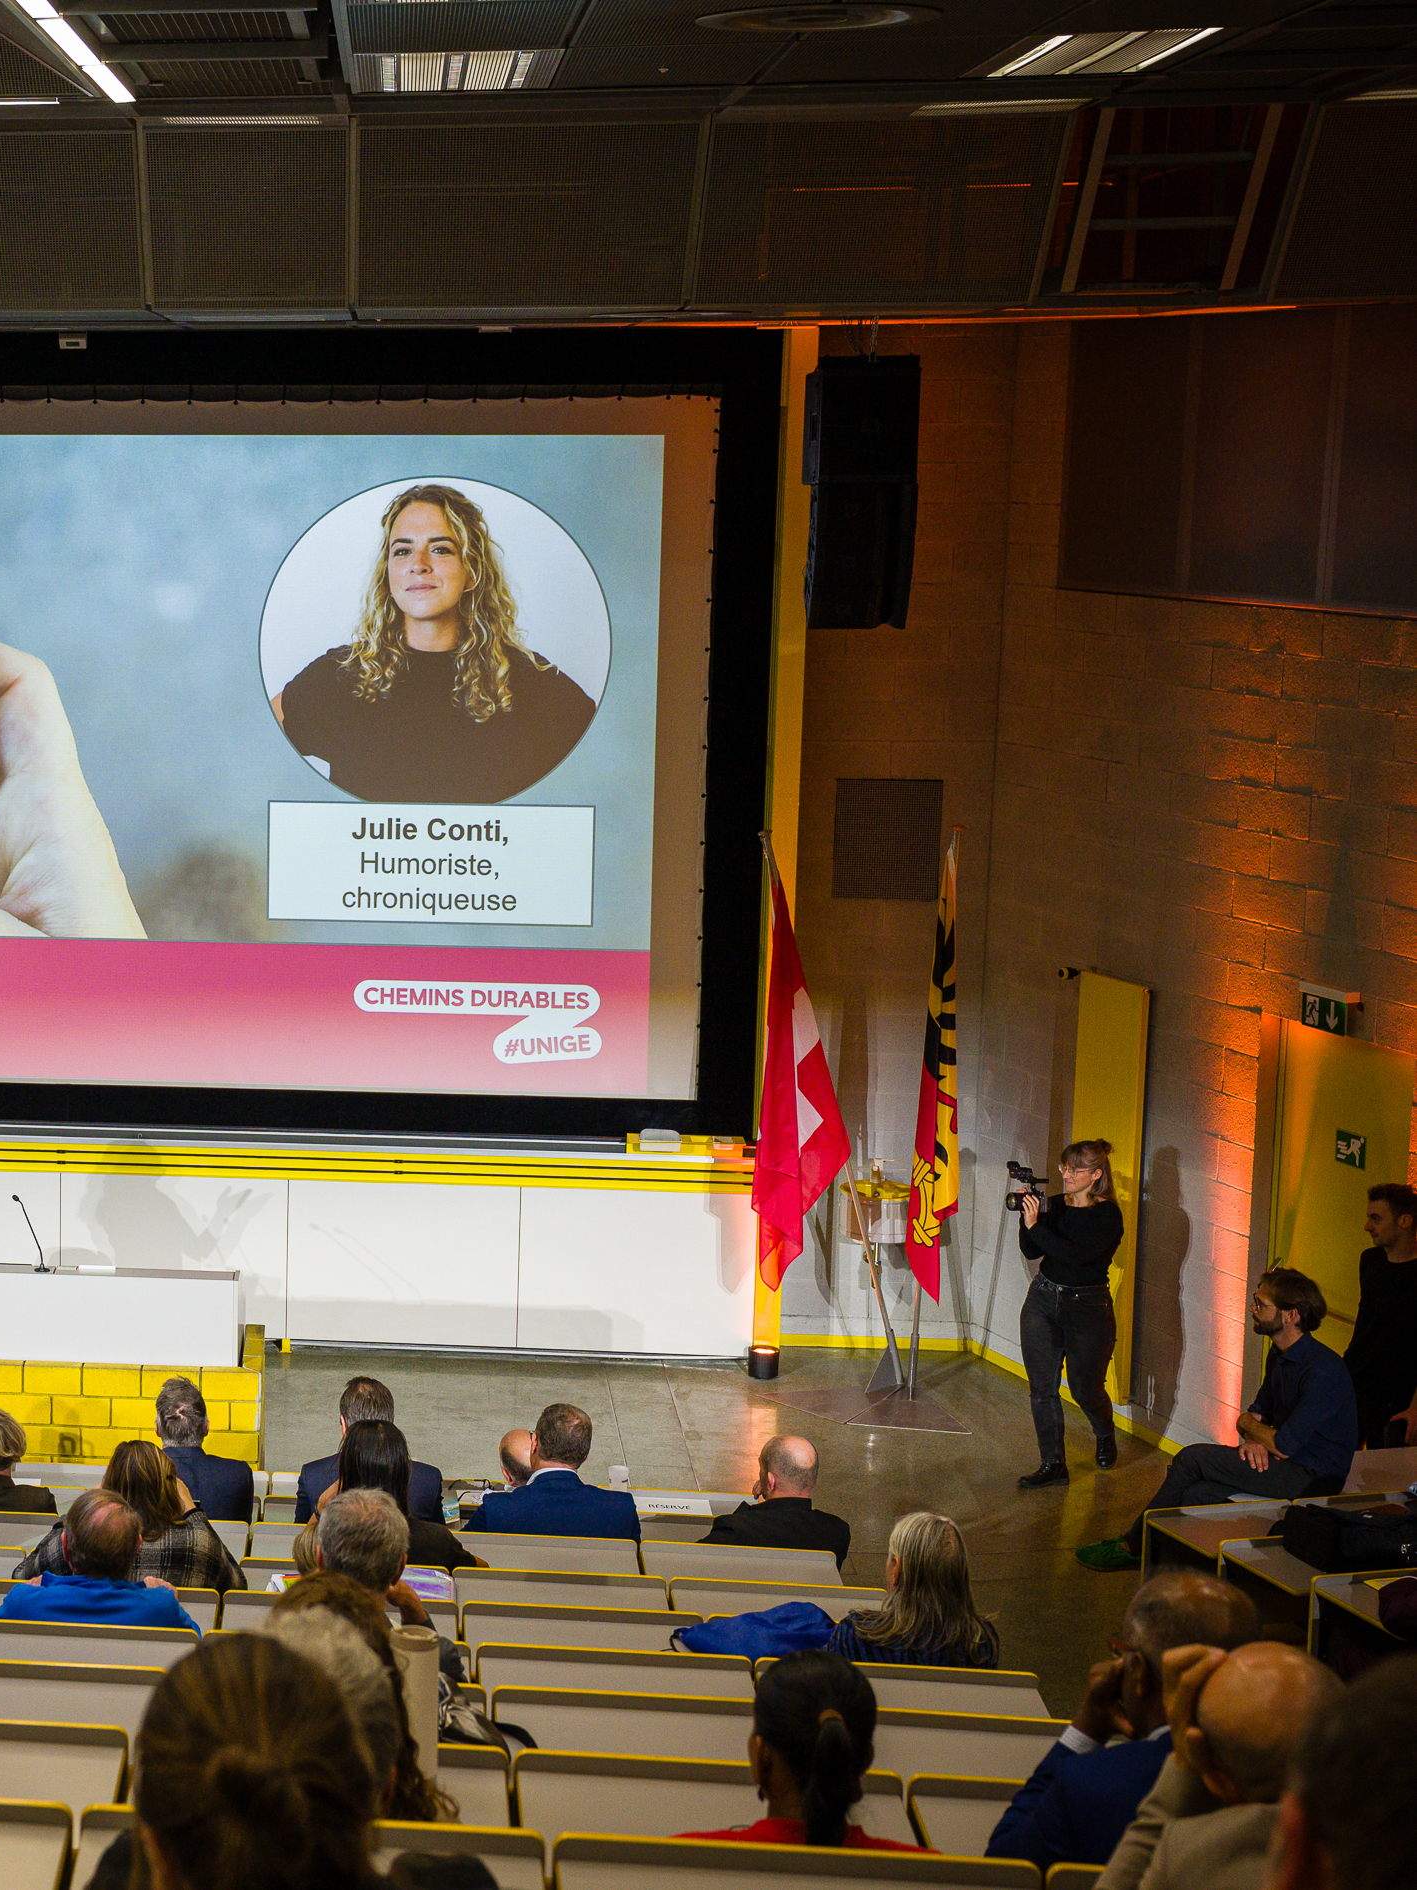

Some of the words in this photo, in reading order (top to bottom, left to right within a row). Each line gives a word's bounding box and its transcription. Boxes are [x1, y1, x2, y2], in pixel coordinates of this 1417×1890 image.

[352, 817, 417, 840] Julie
[427, 818, 508, 846] Conti,
[360, 852, 499, 880] Humoriste,
[342, 886, 517, 915] chroniqueuse
[363, 987, 464, 1007] CHEMINS
[471, 990, 590, 1010] DURABLES
[504, 1034, 591, 1057] #UNIGE
